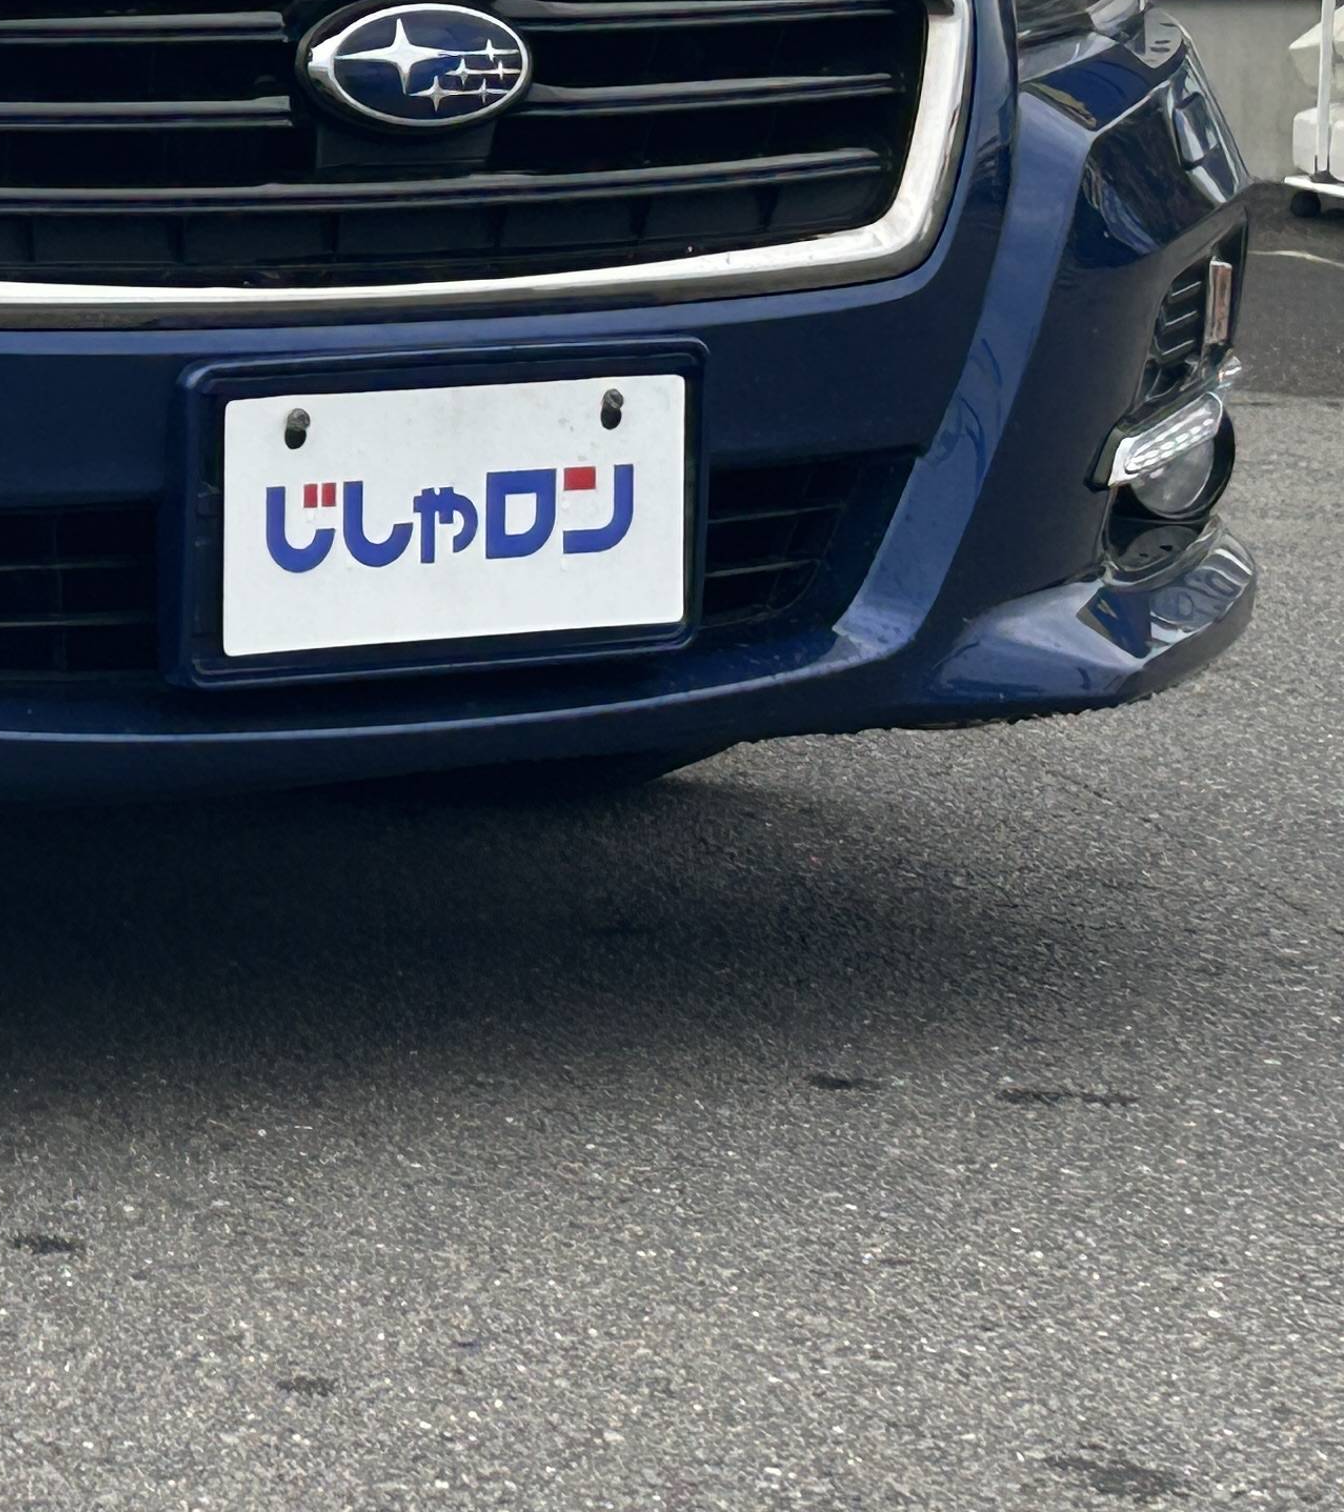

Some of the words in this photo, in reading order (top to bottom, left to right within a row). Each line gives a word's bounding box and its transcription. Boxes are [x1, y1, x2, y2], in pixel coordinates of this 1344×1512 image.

[265, 464, 634, 573] じしゃロン
